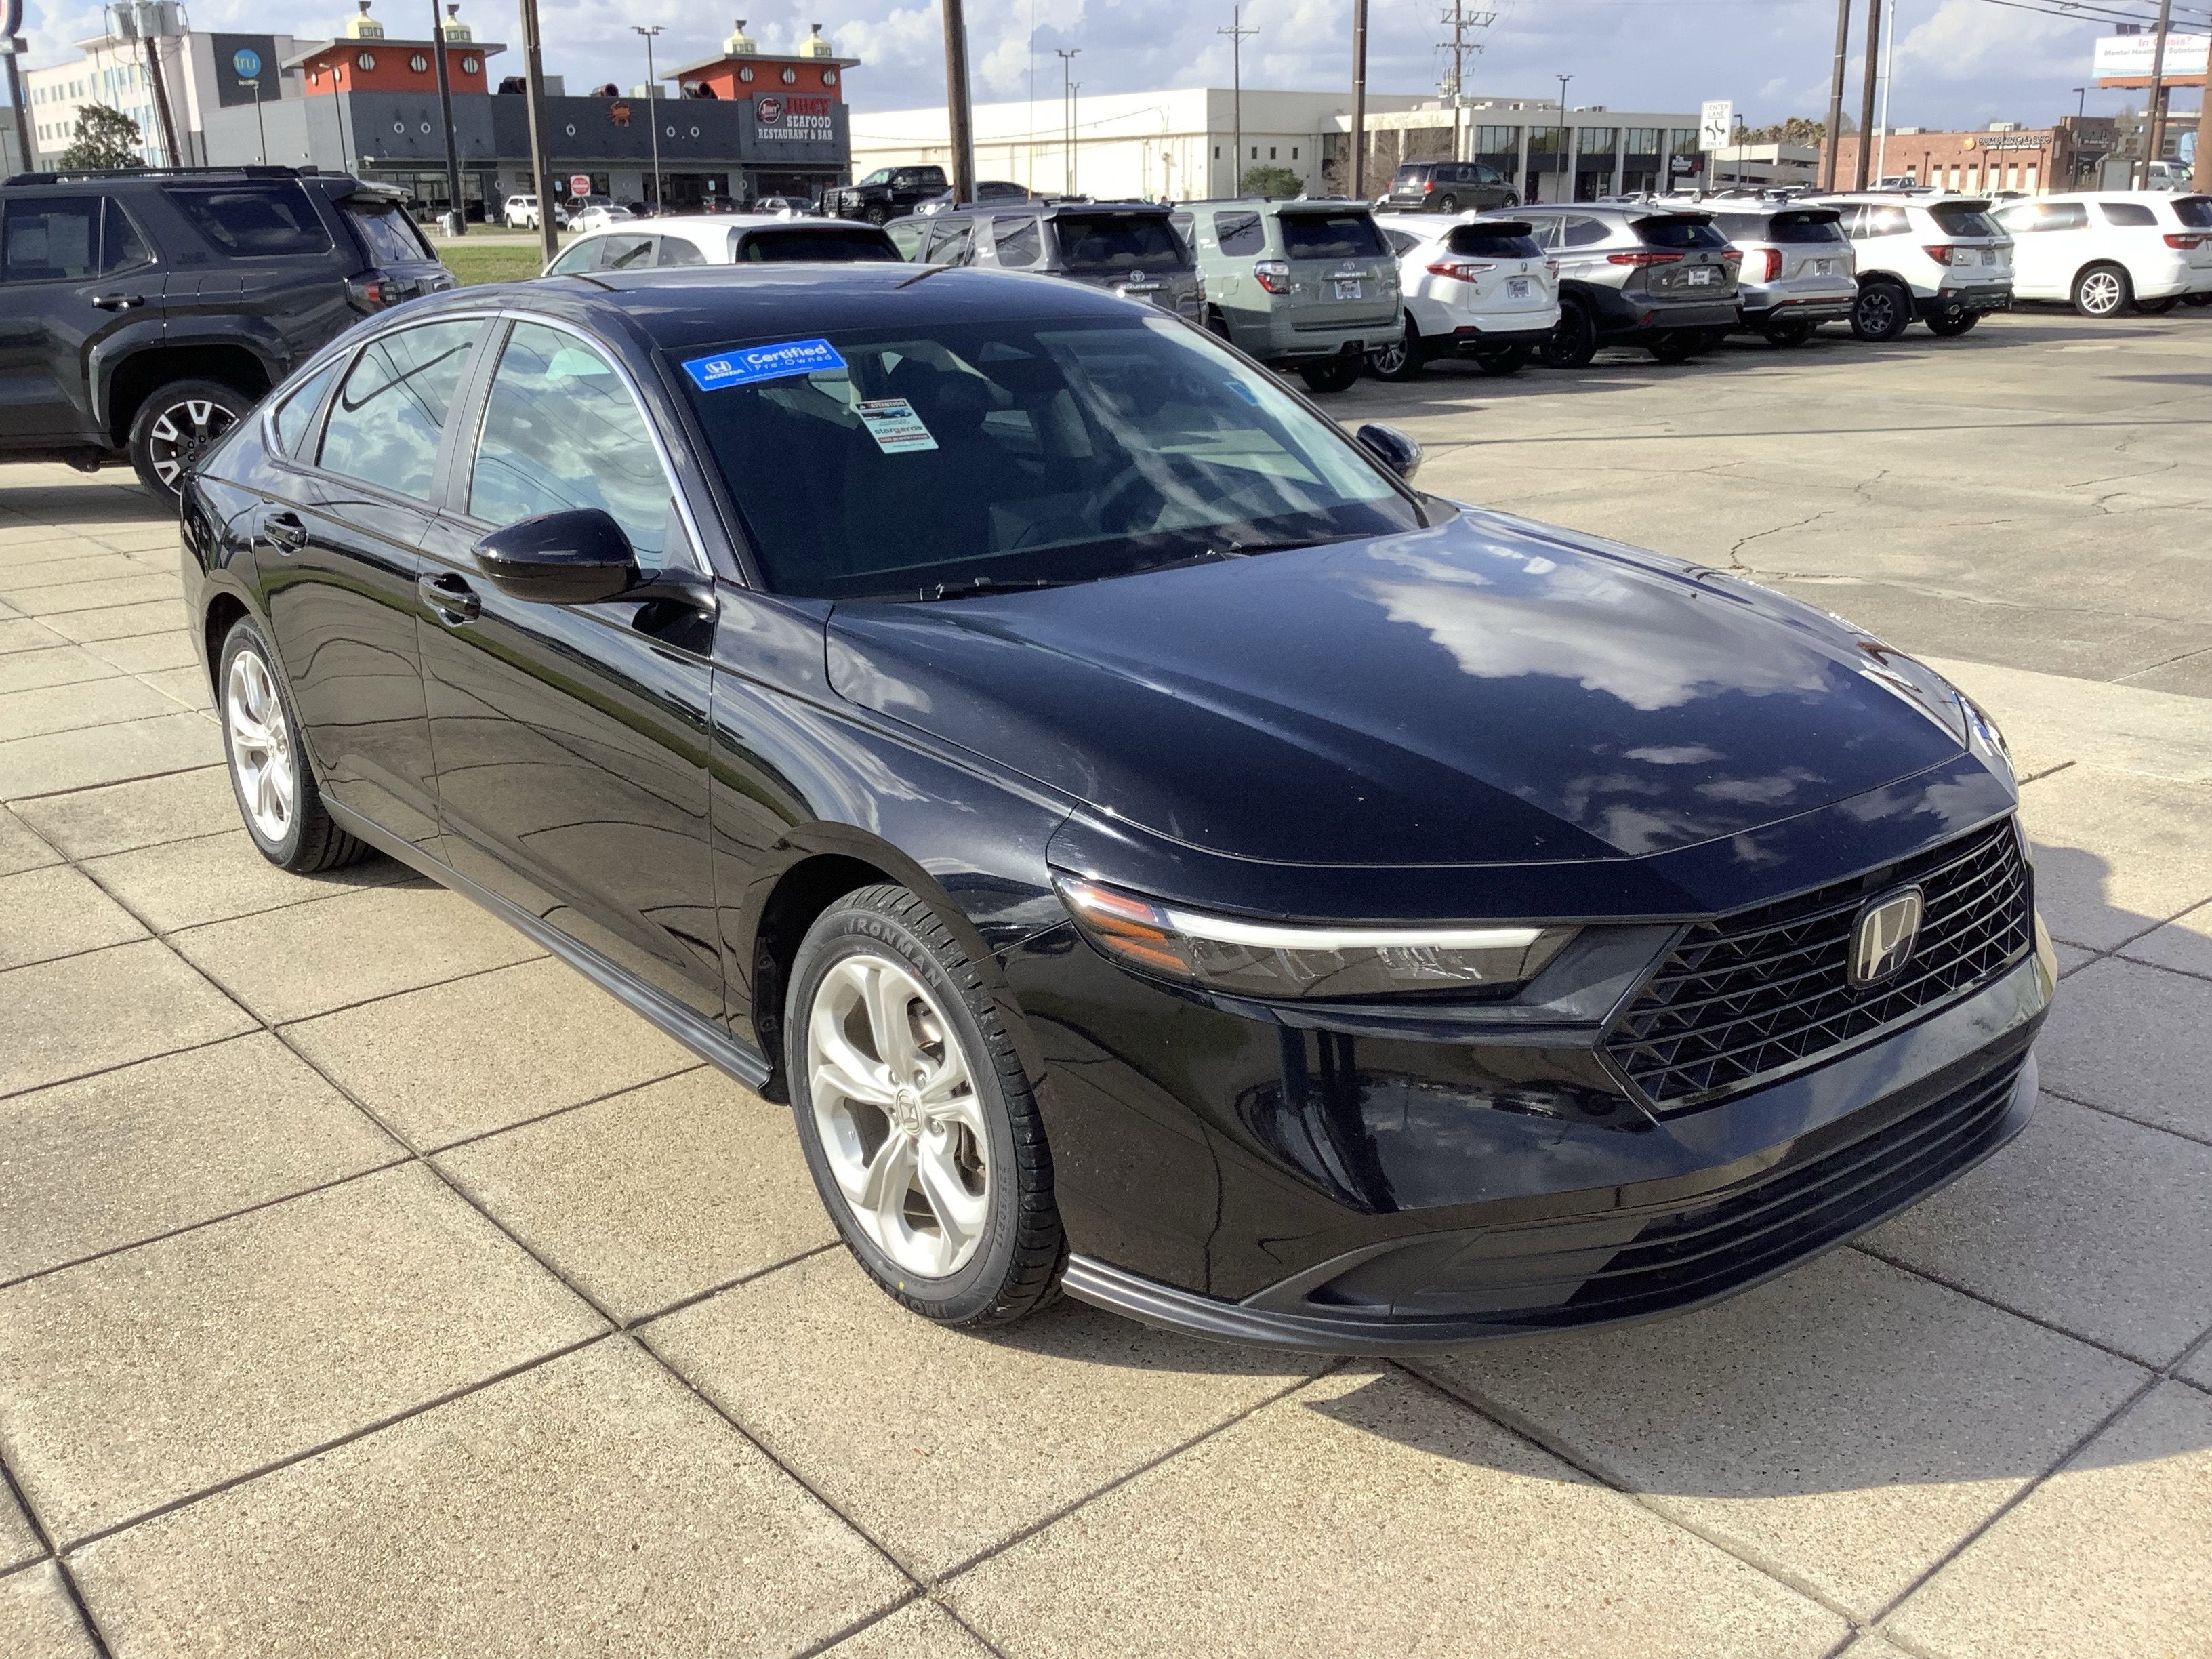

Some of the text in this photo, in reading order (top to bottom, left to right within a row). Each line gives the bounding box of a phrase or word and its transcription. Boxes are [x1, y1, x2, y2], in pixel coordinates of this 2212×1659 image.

[2139, 36, 2192, 47] In Cisis?
[233, 56, 256, 70] tru
[787, 115, 832, 128] SEAFOOD
[758, 128, 833, 140] RESTAURANT & BAR
[1978, 136, 2023, 145] DUMPING
[747, 344, 827, 364] Certified
[754, 354, 832, 370] Pre-Owned
[704, 368, 746, 380] HONDA
[847, 917, 943, 988] IRONMAN
